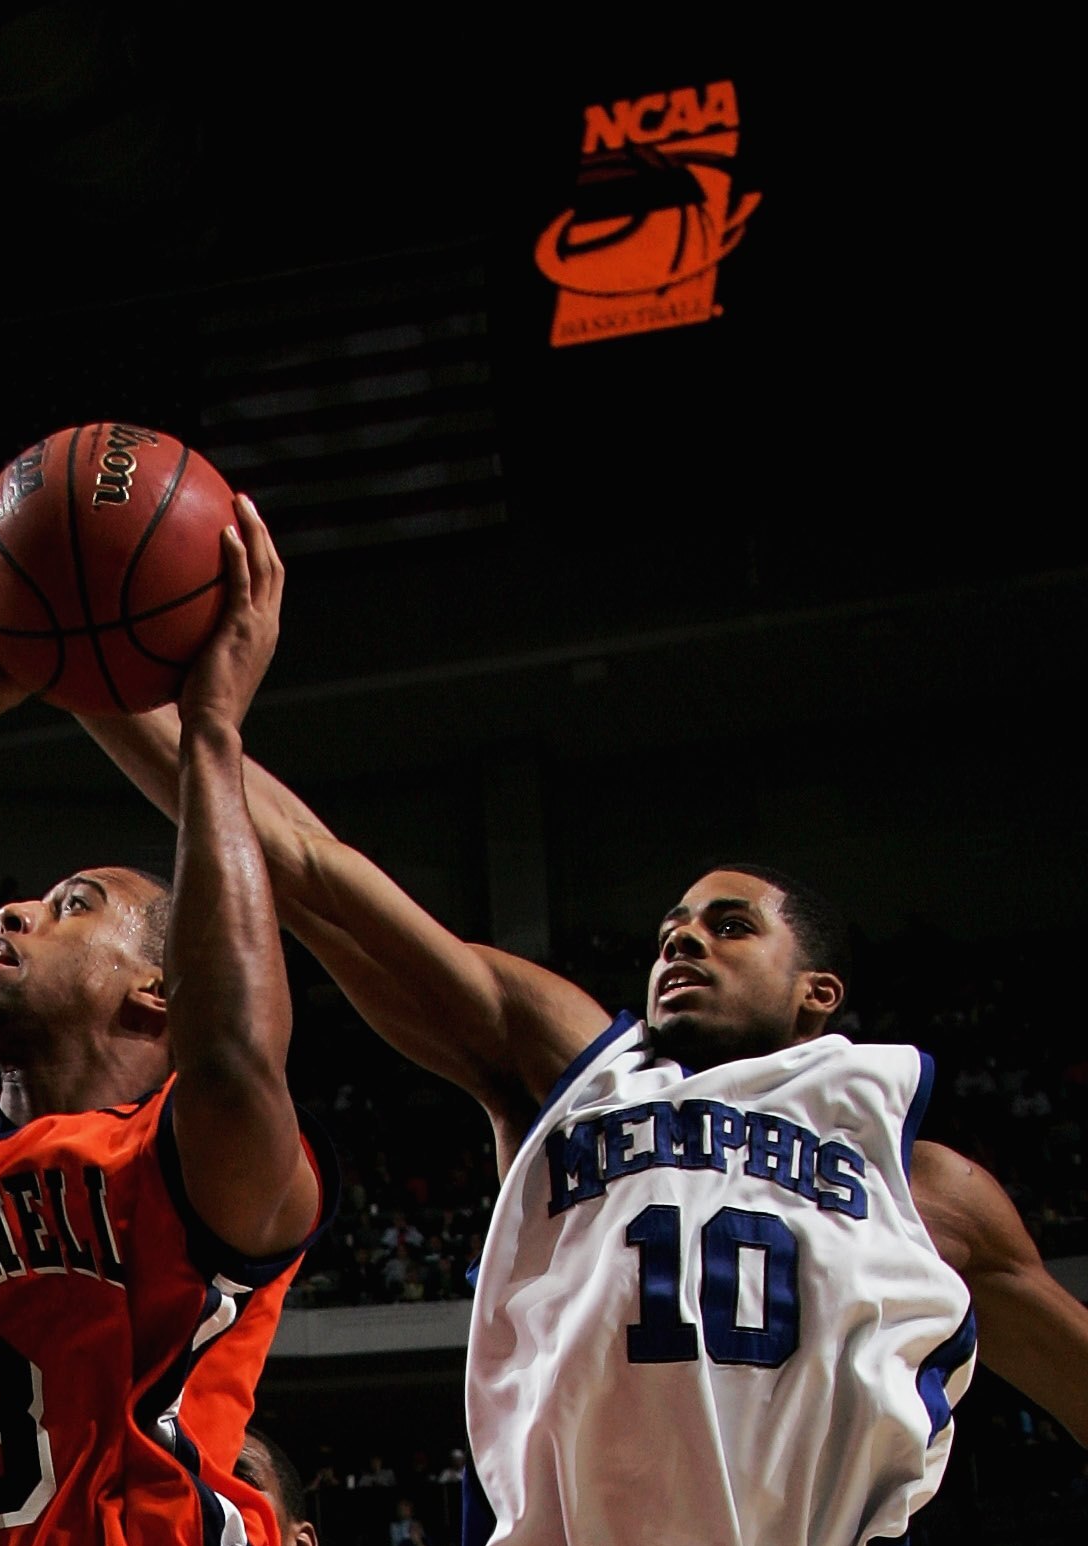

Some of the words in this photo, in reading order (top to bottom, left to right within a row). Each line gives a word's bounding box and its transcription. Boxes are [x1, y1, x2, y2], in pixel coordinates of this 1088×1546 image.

[582, 80, 740, 154] NCAA
[545, 1099, 869, 1220] MEMPHIS
[625, 1204, 800, 1370] 10
